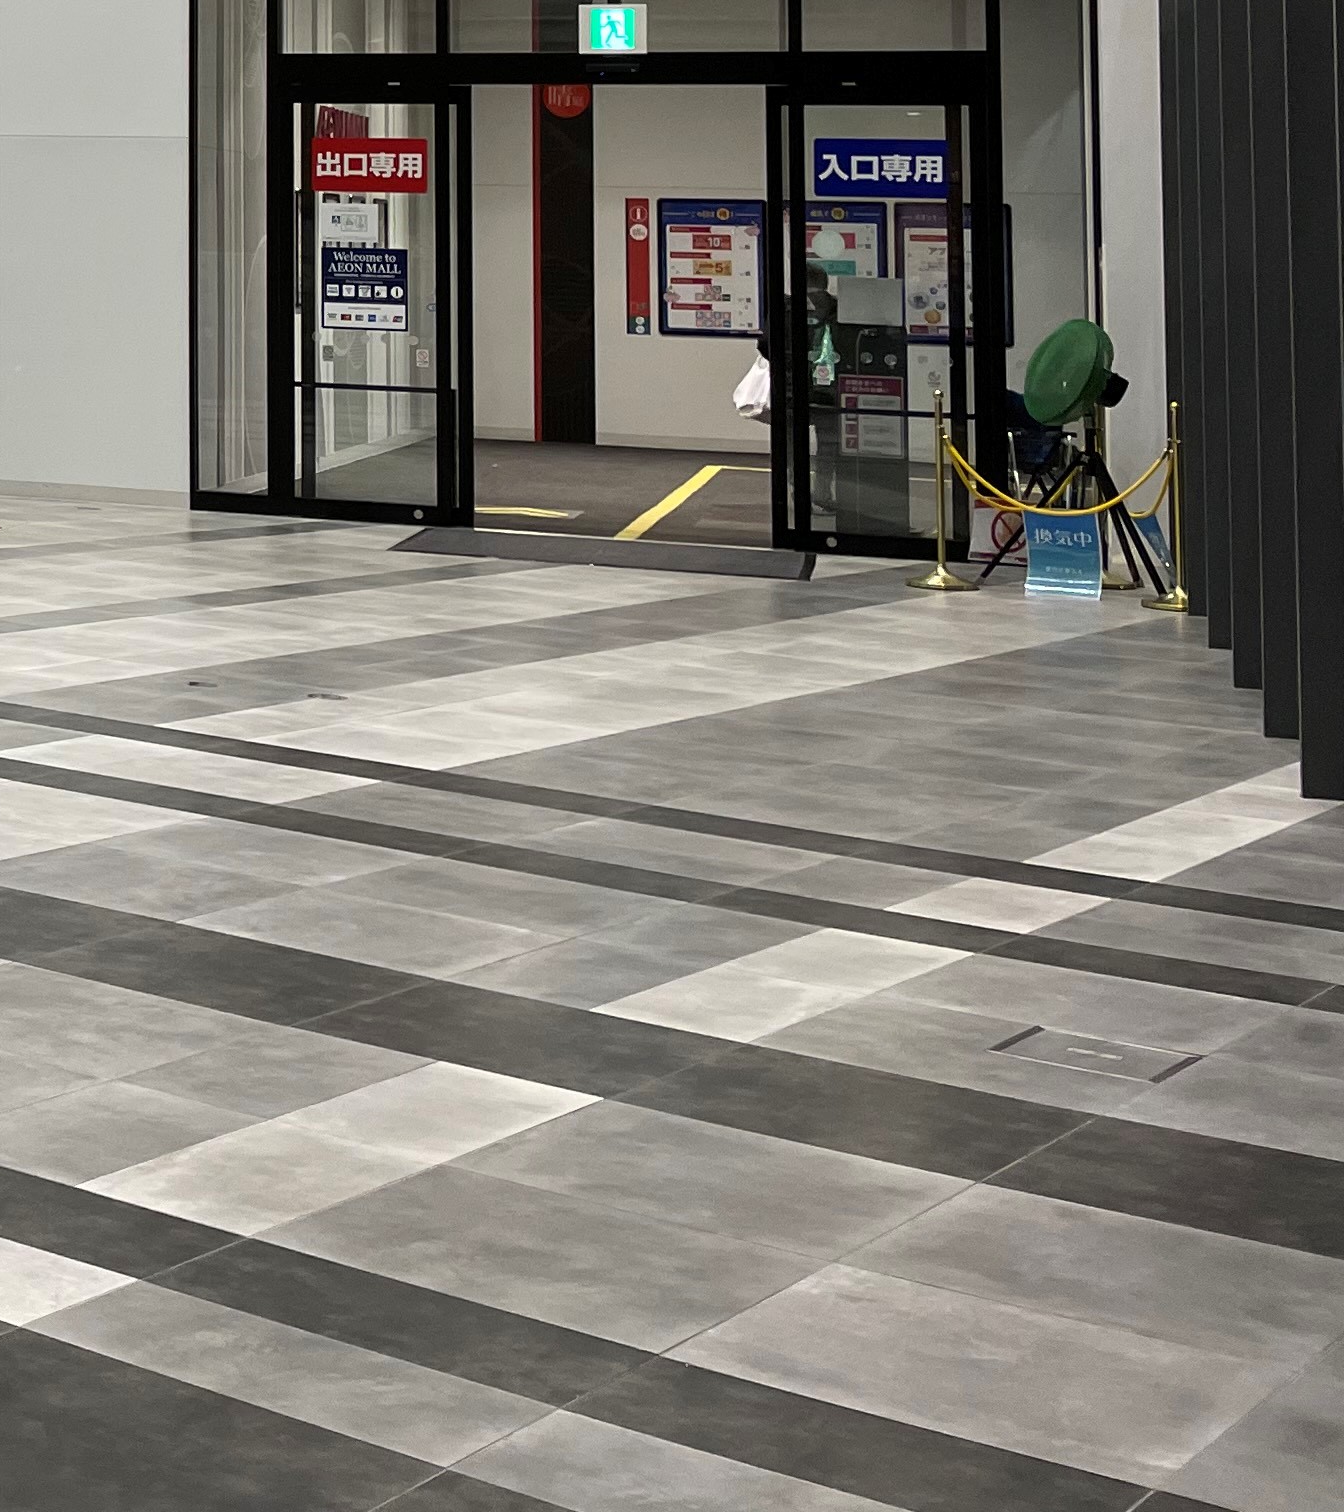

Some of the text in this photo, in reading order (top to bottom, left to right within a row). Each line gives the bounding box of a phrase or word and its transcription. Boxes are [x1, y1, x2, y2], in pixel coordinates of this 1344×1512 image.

[316, 151, 423, 179] 出口専用
[818, 153, 943, 183] 入口専用
[332, 251, 397, 263] Welcome to
[328, 262, 402, 274] AEON MALL
[1033, 527, 1093, 548] 換気中
